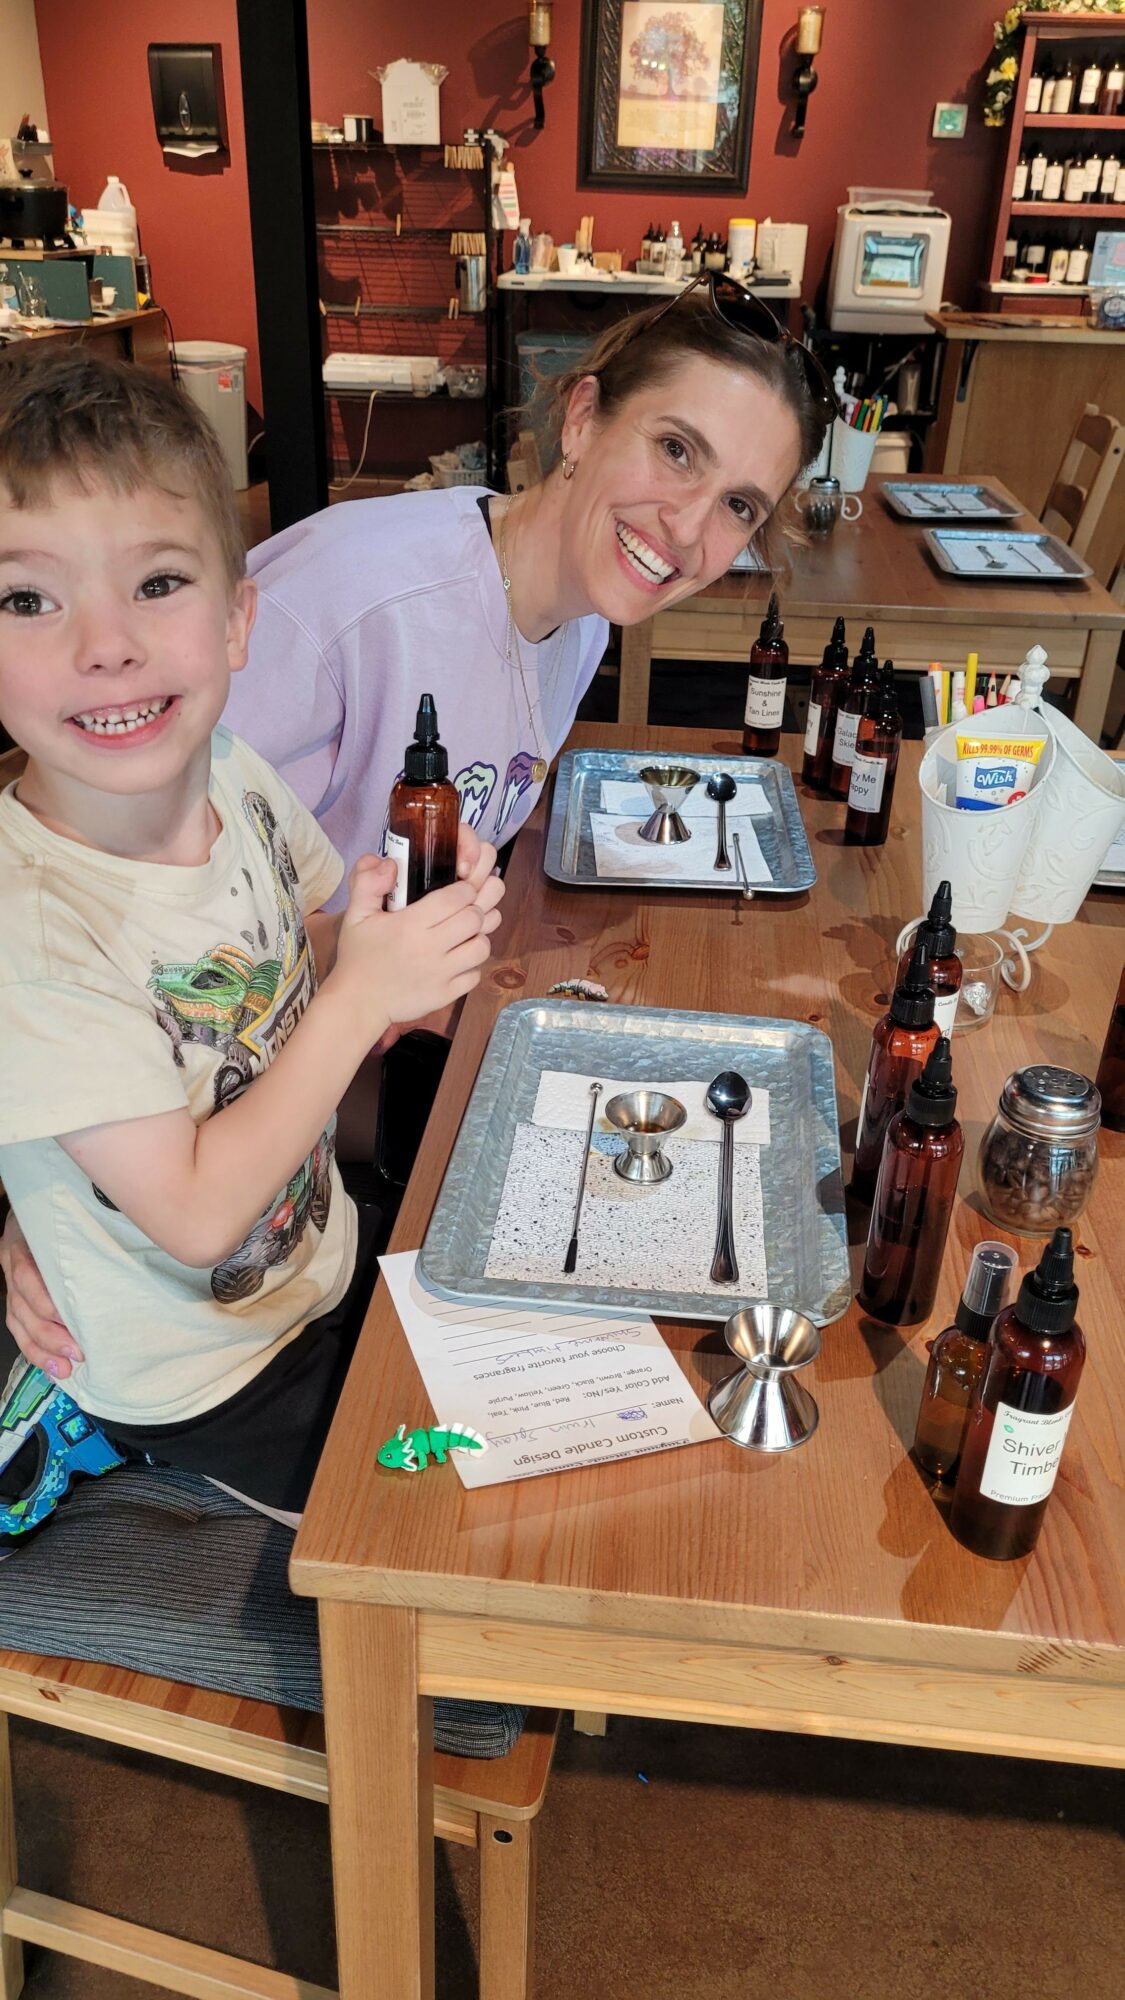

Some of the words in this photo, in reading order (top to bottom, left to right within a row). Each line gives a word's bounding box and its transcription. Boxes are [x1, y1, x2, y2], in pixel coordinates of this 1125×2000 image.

[751, 688, 781, 697] Sunshine
[749, 707, 759, 715] Tan
[837, 727, 857, 738] Galac
[839, 739, 854, 748] Skie
[963, 742, 978, 754] KILLS
[980, 744, 1002, 754] 99.99%
[1004, 746, 1011, 754] OF
[1013, 745, 1033, 757] GERMS
[862, 774, 876, 783] Me
[977, 770, 1013, 786] Wish
[851, 784, 869, 796] appy
[568, 1350, 589, 1361] your
[592, 1344, 625, 1357] Choose
[528, 1356, 566, 1370] favorite
[473, 1364, 525, 1381] fragrances
[597, 1371, 622, 1381] Brown,
[625, 1366, 652, 1376] Orange,
[572, 1379, 595, 1388] Black,
[624, 1378, 649, 1393] Color
[652, 1374, 670, 1386] Add
[515, 1388, 543, 1399] Yellow,
[545, 1383, 570, 1393] Green,
[583, 1385, 622, 1400] Yes/No:
[488, 1394, 513, 1405] Purple
[532, 1400, 551, 1409] Blue,
[553, 1395, 570, 1406] Red,
[652, 1397, 683, 1409] Name:
[487, 1409, 507, 1418] Teal,
[509, 1404, 529, 1415] Pink,
[1003, 1410, 1039, 1425] Fragrant
[616, 1426, 668, 1443] Custom
[564, 1435, 613, 1456] Candle
[1003, 1438, 1061, 1456] Shiver
[513, 1443, 561, 1468] Design
[1010, 1458, 1059, 1476] Timbe
[990, 1490, 1028, 1502] Premium
